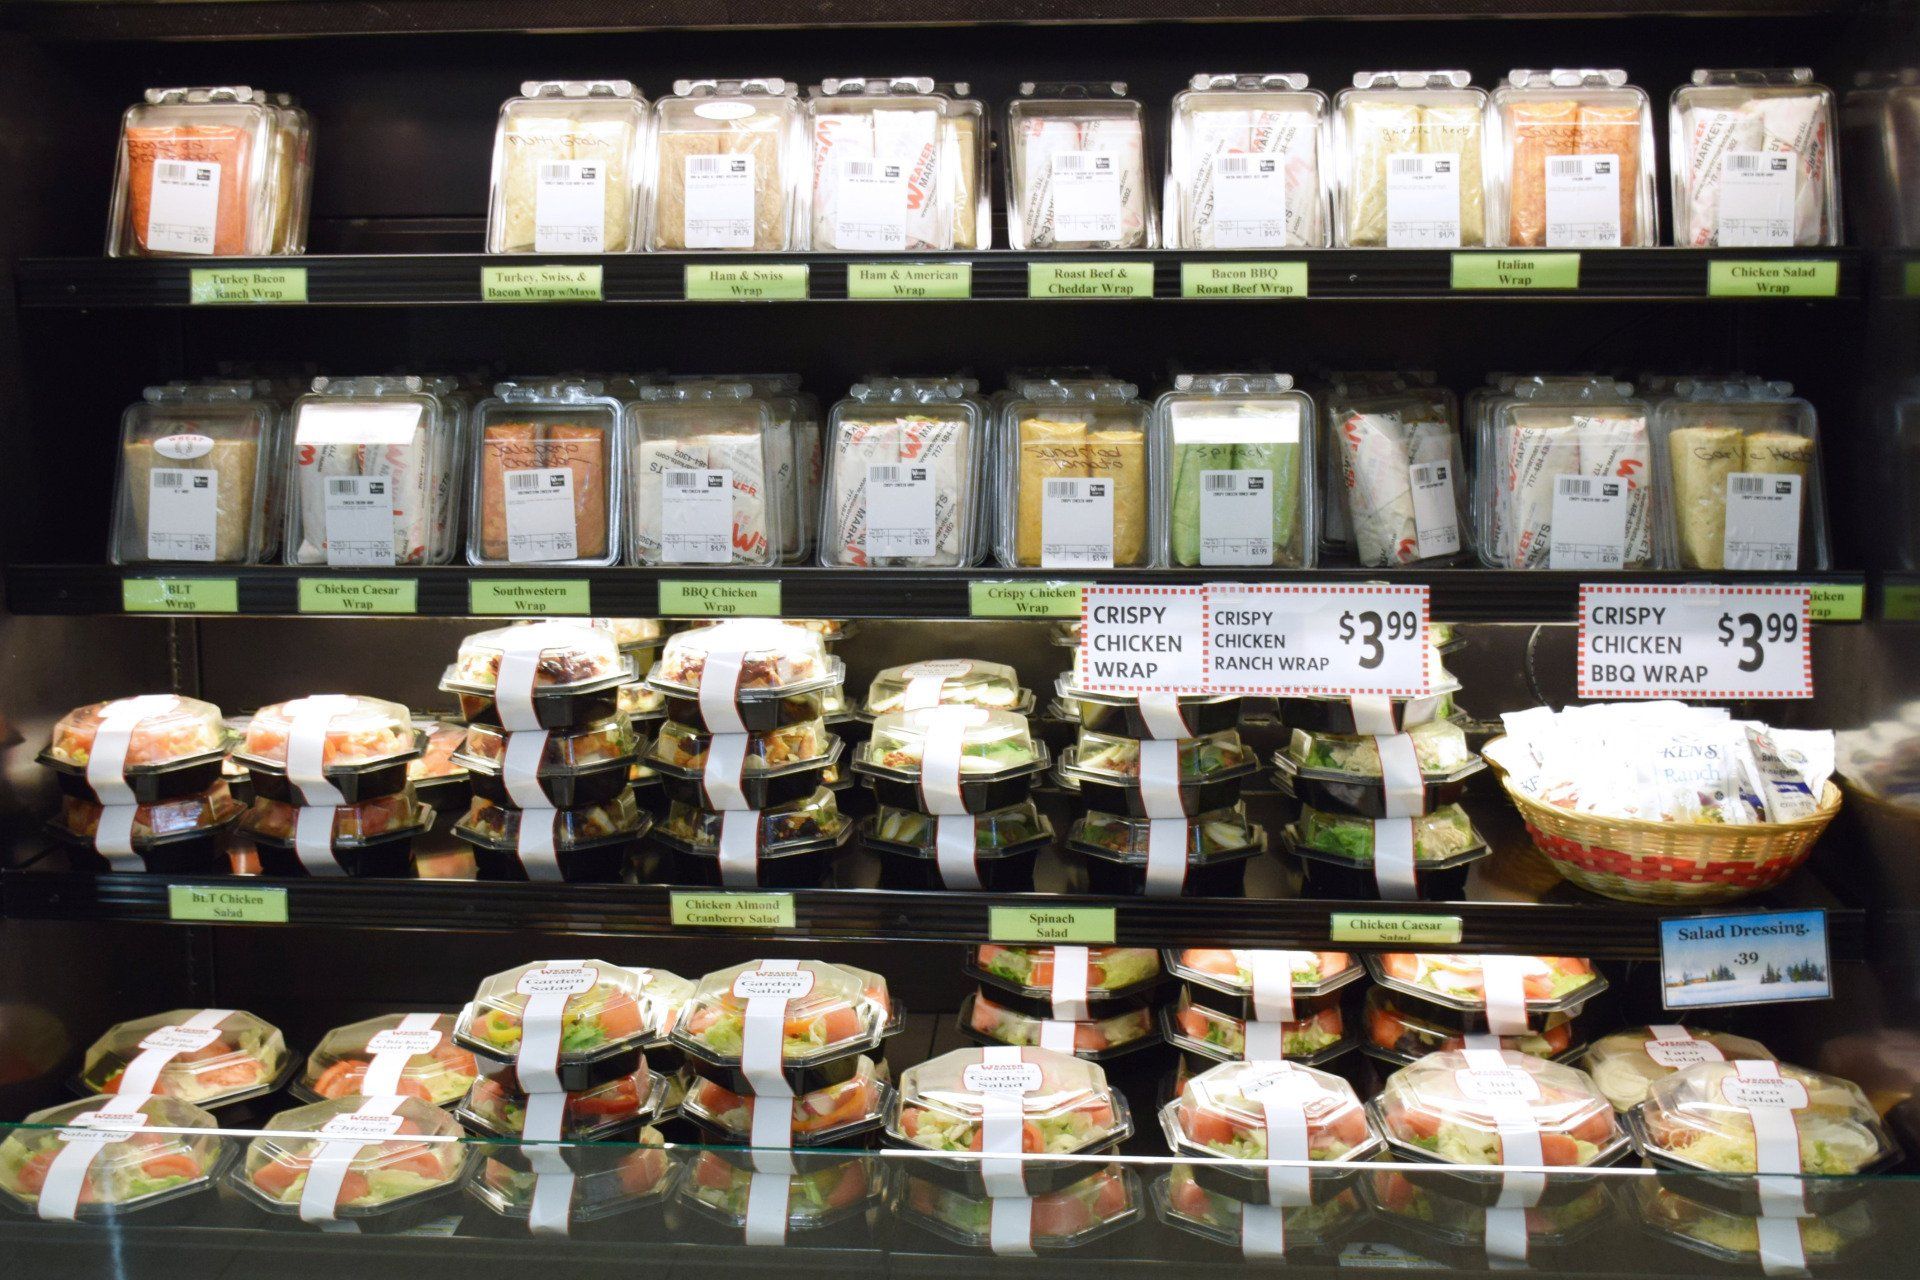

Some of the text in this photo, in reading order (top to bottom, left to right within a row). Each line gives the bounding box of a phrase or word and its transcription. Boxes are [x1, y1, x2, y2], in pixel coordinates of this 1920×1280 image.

[1497, 260, 1535, 270] Italian
[577, 272, 587, 282] &
[709, 271, 784, 281] Ham & Swiss
[860, 270, 959, 280] Ham & American
[1054, 268, 1128, 278] Roast Beef &
[1212, 268, 1278, 279] Bacon BBQ
[1731, 267, 1816, 277] Chicken Salad
[212, 274, 285, 286] Turkey Bacon
[1499, 275, 1532, 286] Wrap
[488, 287, 596, 299] Bacon Wrap w/Mayo
[731, 286, 763, 297] Wrap
[893, 286, 925, 296] Wrap
[1048, 283, 1134, 295] Cheddar Wrap
[1197, 283, 1293, 295] Roast Beef Wrap
[1757, 282, 1790, 293] Wrap
[216, 289, 283, 300] Ranch Wrap
[168, 584, 192, 594] BLT
[315, 584, 400, 595] Chicken Caesar
[493, 586, 567, 596] Southwestern
[682, 587, 757, 598] BBQ Chicken
[988, 588, 1076, 599] Crispy Chicken
[166, 600, 196, 610] Wrap
[343, 599, 373, 610] Wrap
[515, 601, 546, 611] Wrap
[704, 602, 736, 612] Wrap
[1016, 603, 1049, 613] Wrap
[1093, 606, 1167, 625] CRISPY
[1591, 607, 1666, 625] CRISPY
[1811, 608, 1831, 617] rap
[1214, 611, 1273, 626] CRISPY
[1093, 635, 1183, 653] CHICKEN
[1214, 634, 1286, 650] CHICKEN
[1591, 636, 1682, 655] CHICKEN
[1214, 656, 1330, 672] RANCH WRAP
[1094, 662, 1159, 679] WRAP
[1591, 664, 1708, 684] BBQ WRAP
[1664, 764, 1722, 783] Ranch
[192, 893, 264, 905] BLT Chicken
[685, 900, 780, 910] Chicken Almond
[214, 908, 243, 918] Salad
[686, 913, 780, 925] Cranberry Salad
[1029, 913, 1075, 925] Spinach
[1350, 919, 1442, 931] Chicken Caesar
[1036, 928, 1068, 938] Salad
[1678, 925, 1725, 941] Salad
[1733, 952, 1759, 966] .39
